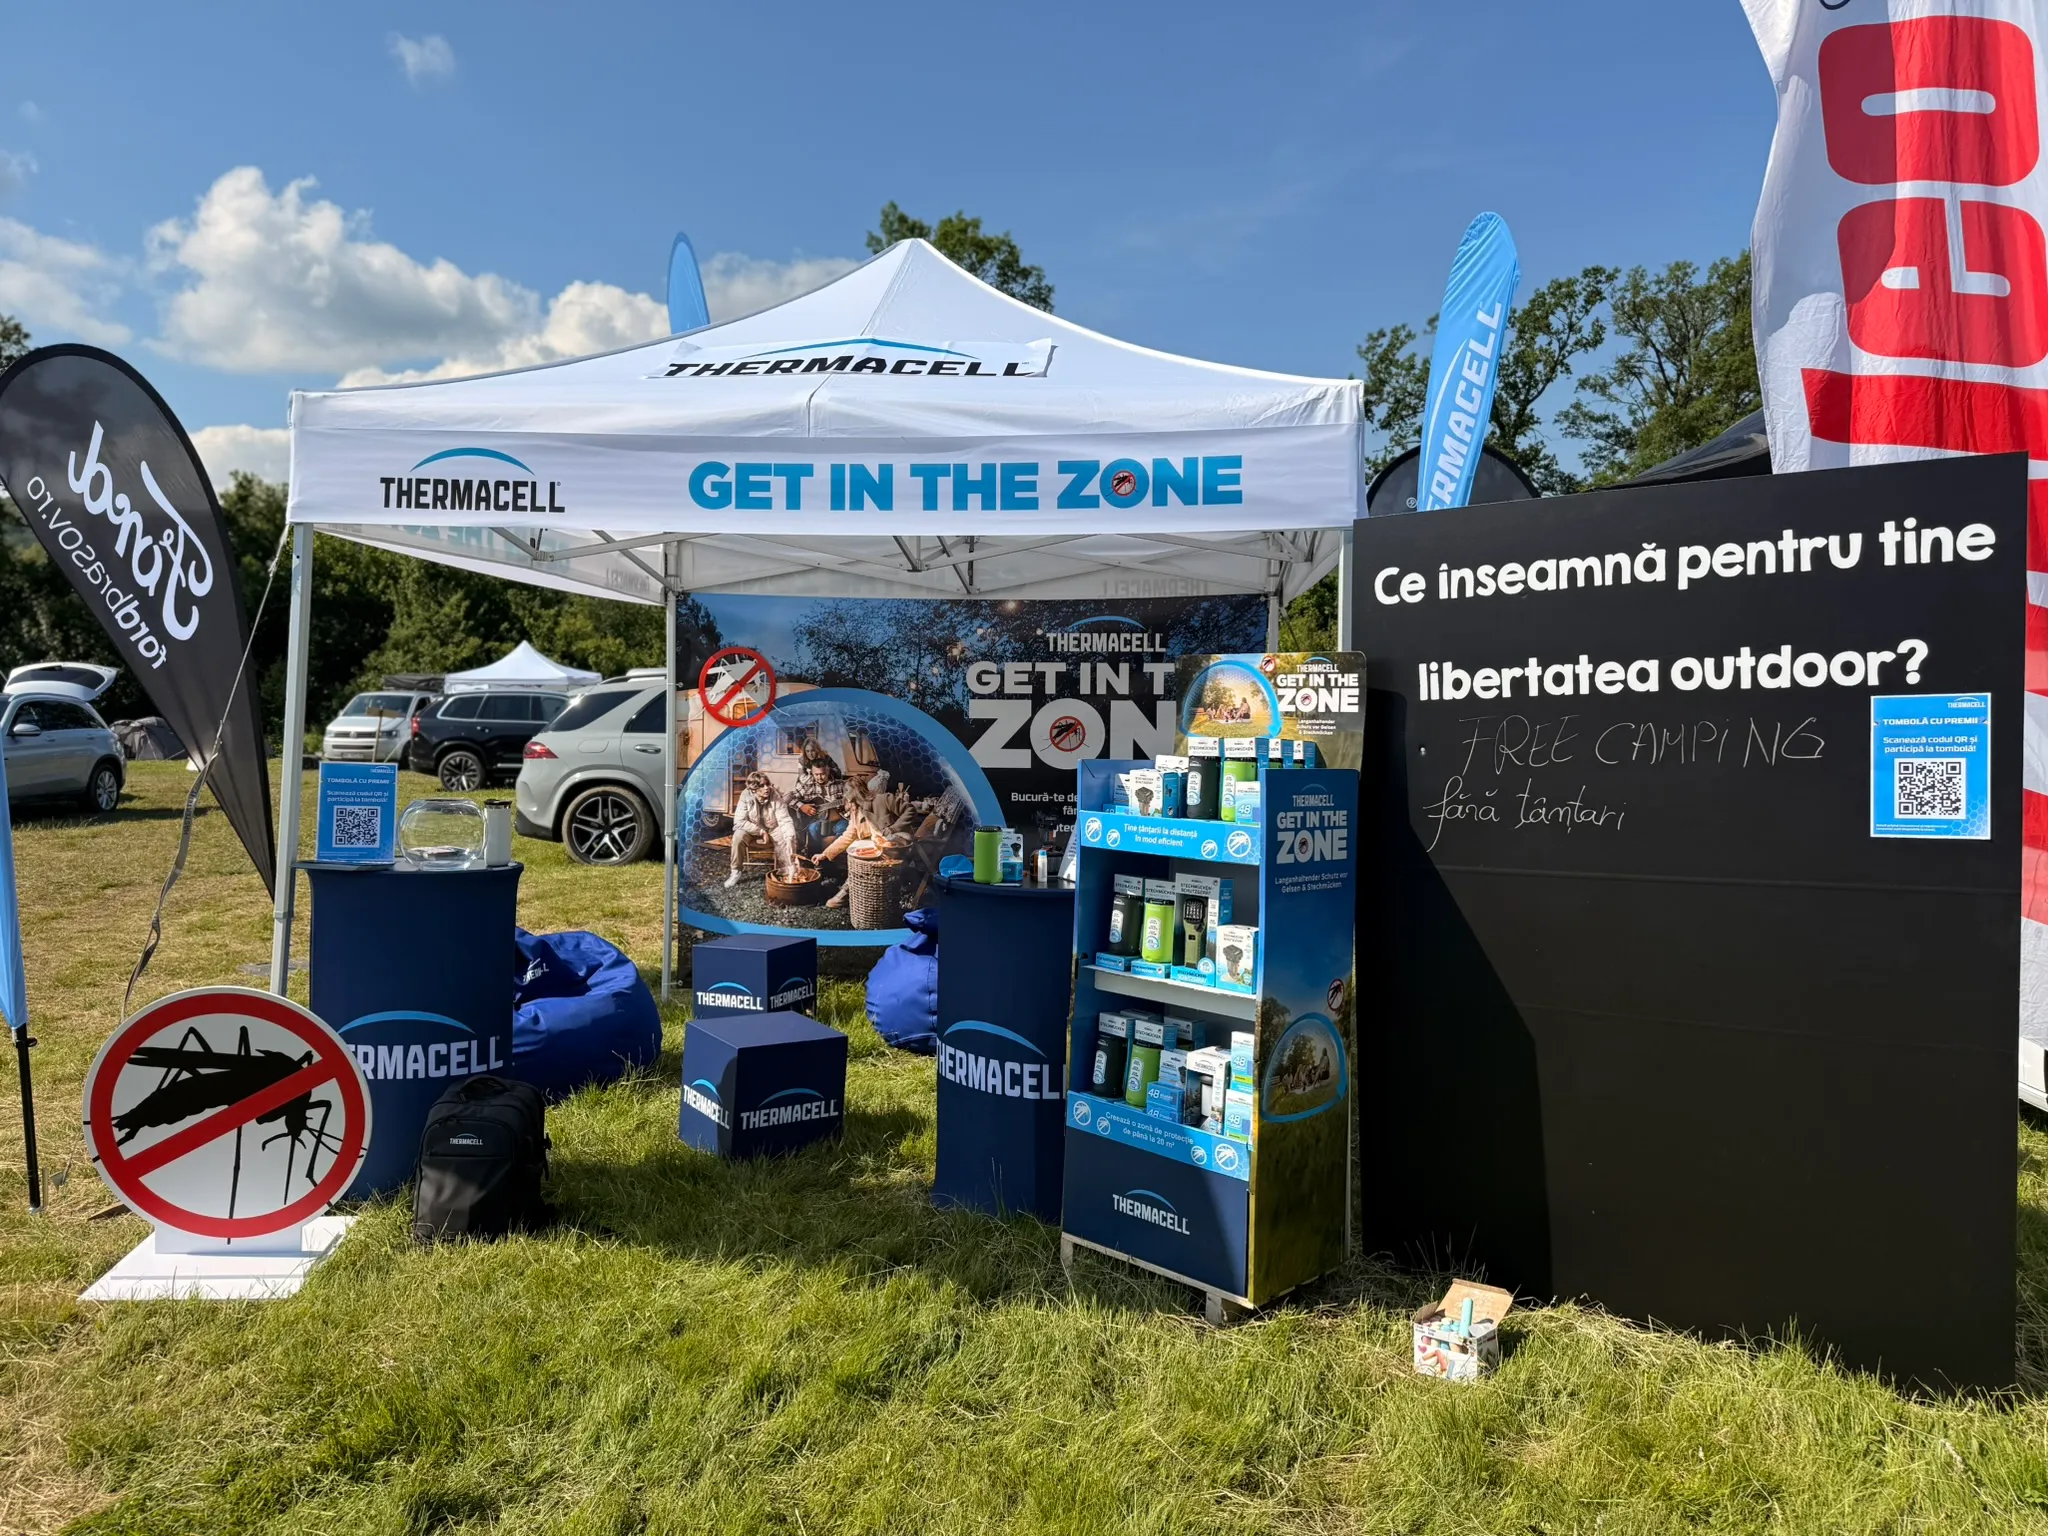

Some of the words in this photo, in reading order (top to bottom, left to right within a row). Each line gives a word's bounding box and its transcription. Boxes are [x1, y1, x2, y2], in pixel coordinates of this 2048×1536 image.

[664, 355, 1036, 378] THERMACELL
[1427, 302, 1502, 511] RMACELL
[688, 461, 814, 511] GET
[830, 463, 893, 512] IN
[910, 462, 1039, 511] THE
[1057, 455, 1243, 509] ZONE
[380, 477, 565, 513] THERMACELL
[1374, 566, 1426, 606] Ce
[1438, 542, 1667, 600] înseamnă
[1677, 529, 1863, 591] pentru
[1878, 517, 1996, 566] tine
[1046, 632, 1166, 652] THERMACELL
[966, 661, 1066, 694] GET
[1080, 662, 1130, 695] IN
[1296, 664, 1339, 673] THERMACELL
[1418, 654, 1660, 701] libertatea
[1671, 638, 1929, 692] outdoor?
[1276, 673, 1306, 687] GET
[1309, 673, 1325, 687] IN
[1327, 673, 1359, 687] THE
[1277, 687, 1359, 713] ZONE
[1944, 717, 1978, 725] PREMII
[968, 698, 1177, 770] ZON
[1883, 736, 1927, 744] Scanează
[1928, 735, 1953, 743] codul
[1954, 736, 1968, 744] QR
[1459, 714, 1579, 775] FREE
[1885, 745, 1925, 754] participă
[1011, 792, 1065, 802] Bucură-te
[1292, 795, 1334, 807] THERMACELL
[1238, 804, 1251, 815] 48
[1276, 811, 1304, 829] GET
[1306, 811, 1320, 828] IN
[1322, 810, 1347, 827] THE
[1142, 835, 1157, 844] mod
[1158, 837, 1183, 847] eficient
[1162, 827, 1169, 835] la
[1276, 829, 1348, 864] ZONE
[696, 991, 764, 1011] THERMACELL
[769, 984, 815, 1010] THERMACELL
[347, 1036, 503, 1080] RMACELL
[937, 1037, 1067, 1099] HERMACEL
[1233, 1056, 1246, 1068] 48
[1148, 1088, 1160, 1099] 48
[683, 1084, 730, 1130] THERMACELL
[740, 1099, 839, 1130] THERMACELL
[1154, 1125, 1162, 1135] de
[1227, 1114, 1241, 1126] 48
[450, 1137, 483, 1146] THERMACELL
[1123, 1127, 1131, 1135] de
[1149, 1134, 1156, 1143] la
[1112, 1193, 1191, 1235] THERMACELL
